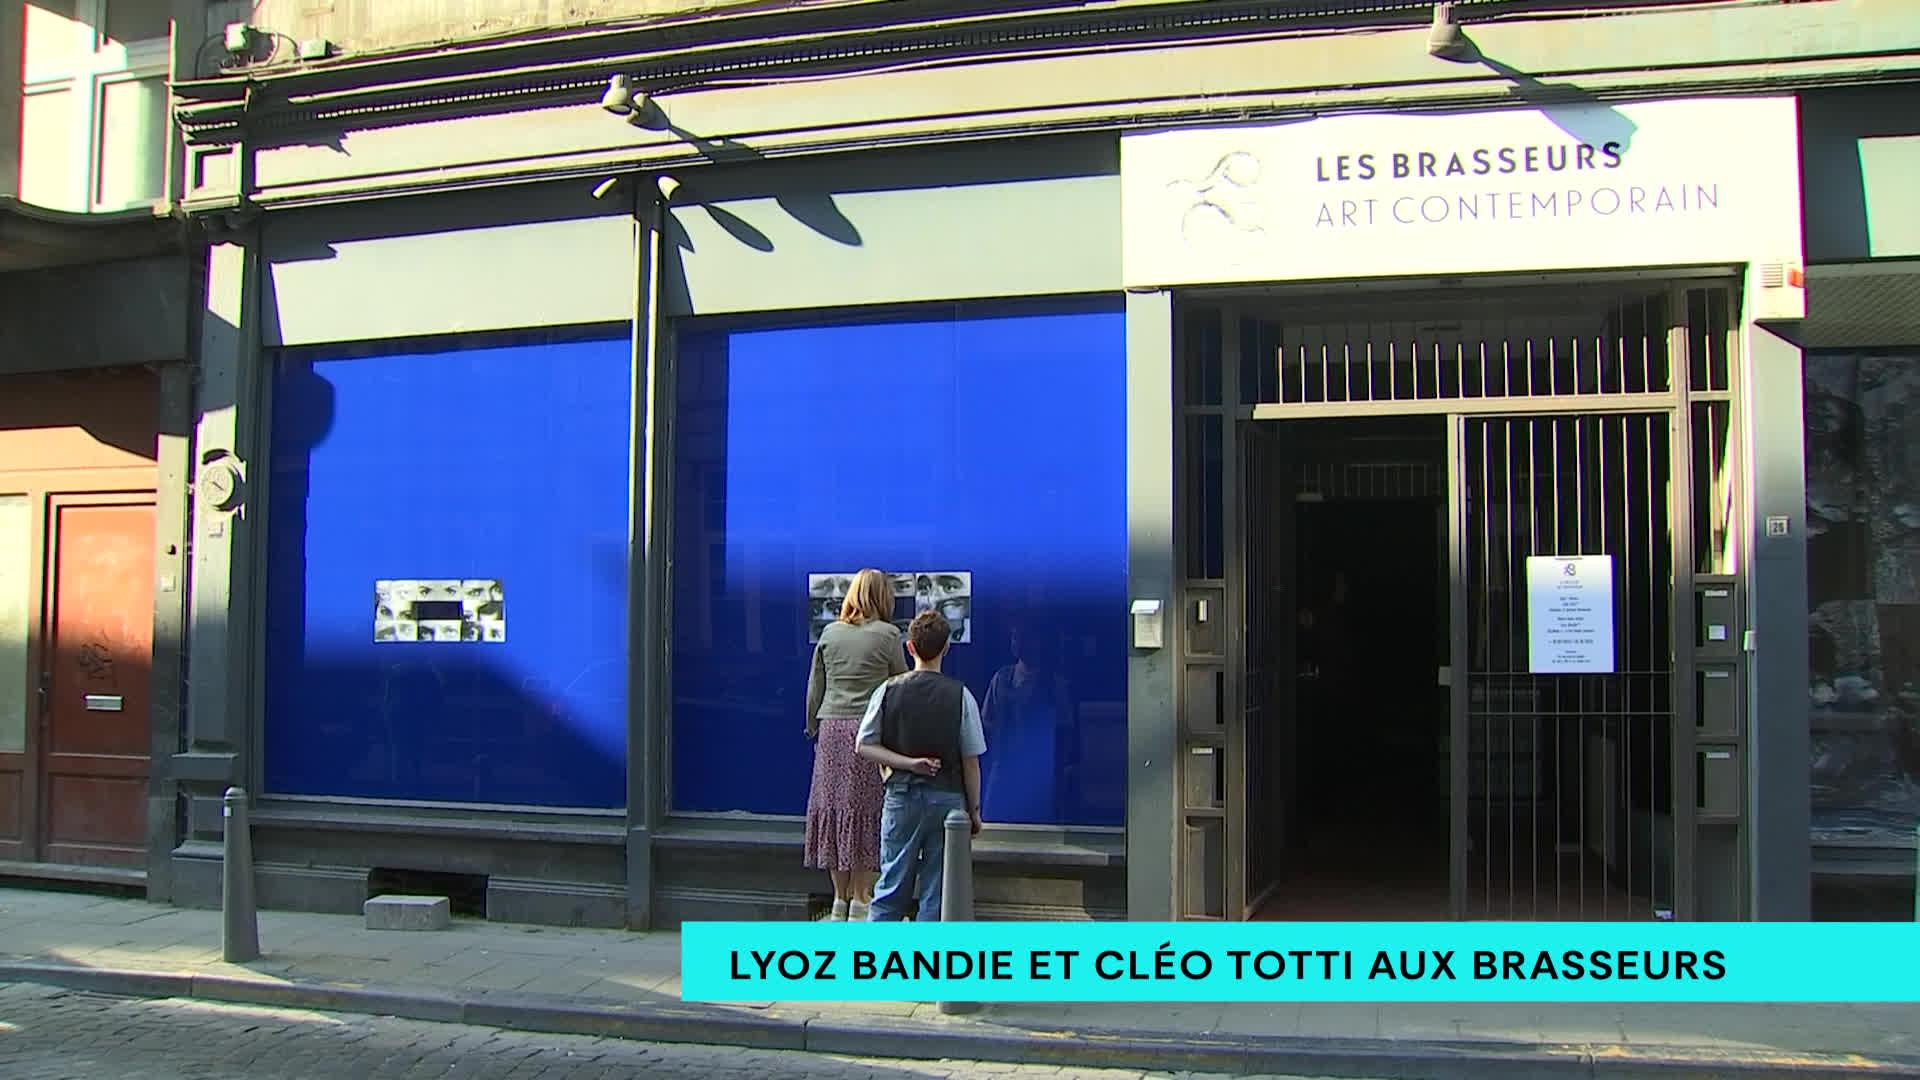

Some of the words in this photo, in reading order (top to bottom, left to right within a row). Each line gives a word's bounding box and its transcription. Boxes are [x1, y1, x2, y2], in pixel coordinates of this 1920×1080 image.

[1316, 153, 1376, 182] LES
[1393, 141, 1622, 179] BRASSEURS
[1316, 199, 1375, 227] ART
[1393, 183, 1719, 225] CONTEMPORAIN
